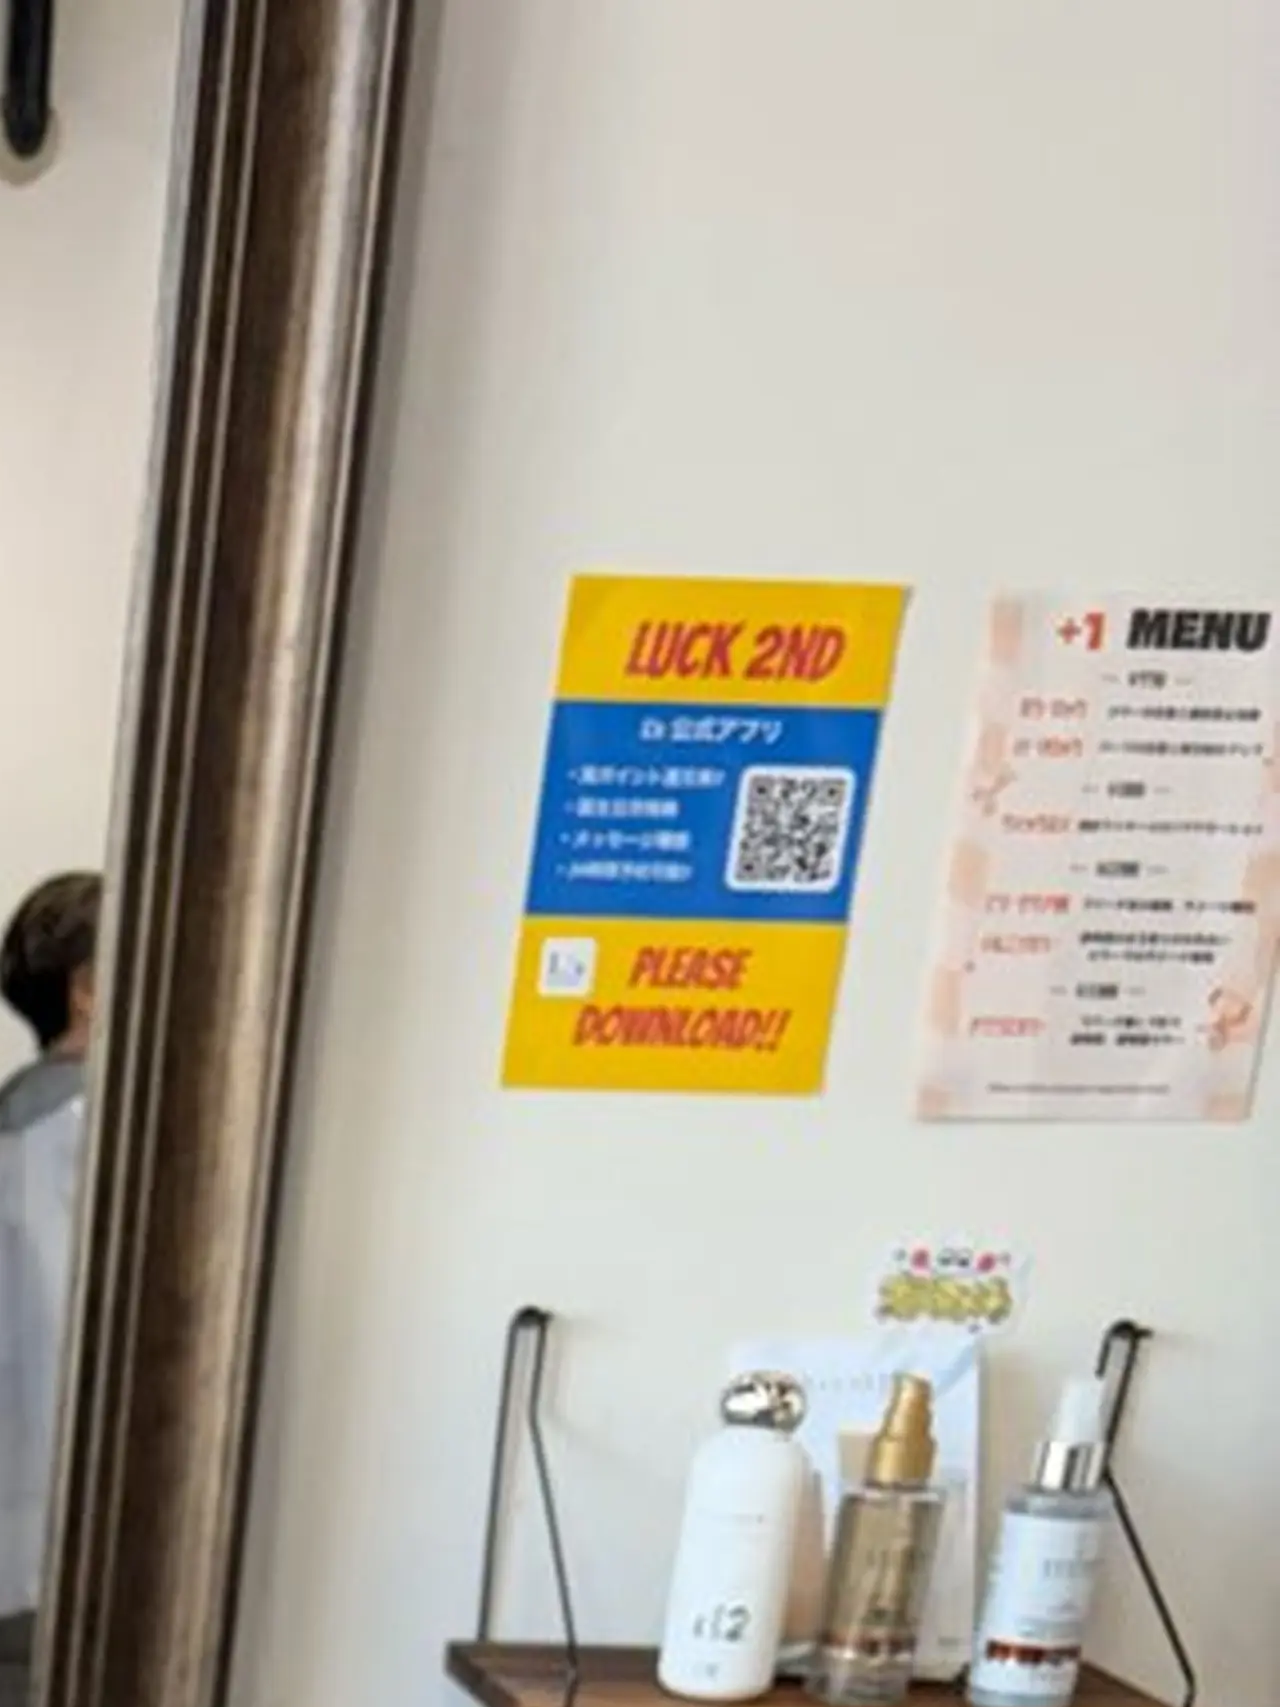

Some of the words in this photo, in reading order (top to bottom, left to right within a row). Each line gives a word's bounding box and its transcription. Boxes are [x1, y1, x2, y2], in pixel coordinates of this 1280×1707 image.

[624, 619, 743, 679] LUCK
[743, 624, 847, 683] 2ND
[1055, 612, 1105, 651] +1
[1126, 608, 1272, 652] MENU
[627, 946, 753, 991] PLEASE
[571, 1005, 792, 1053] DOWNLOAD!!
